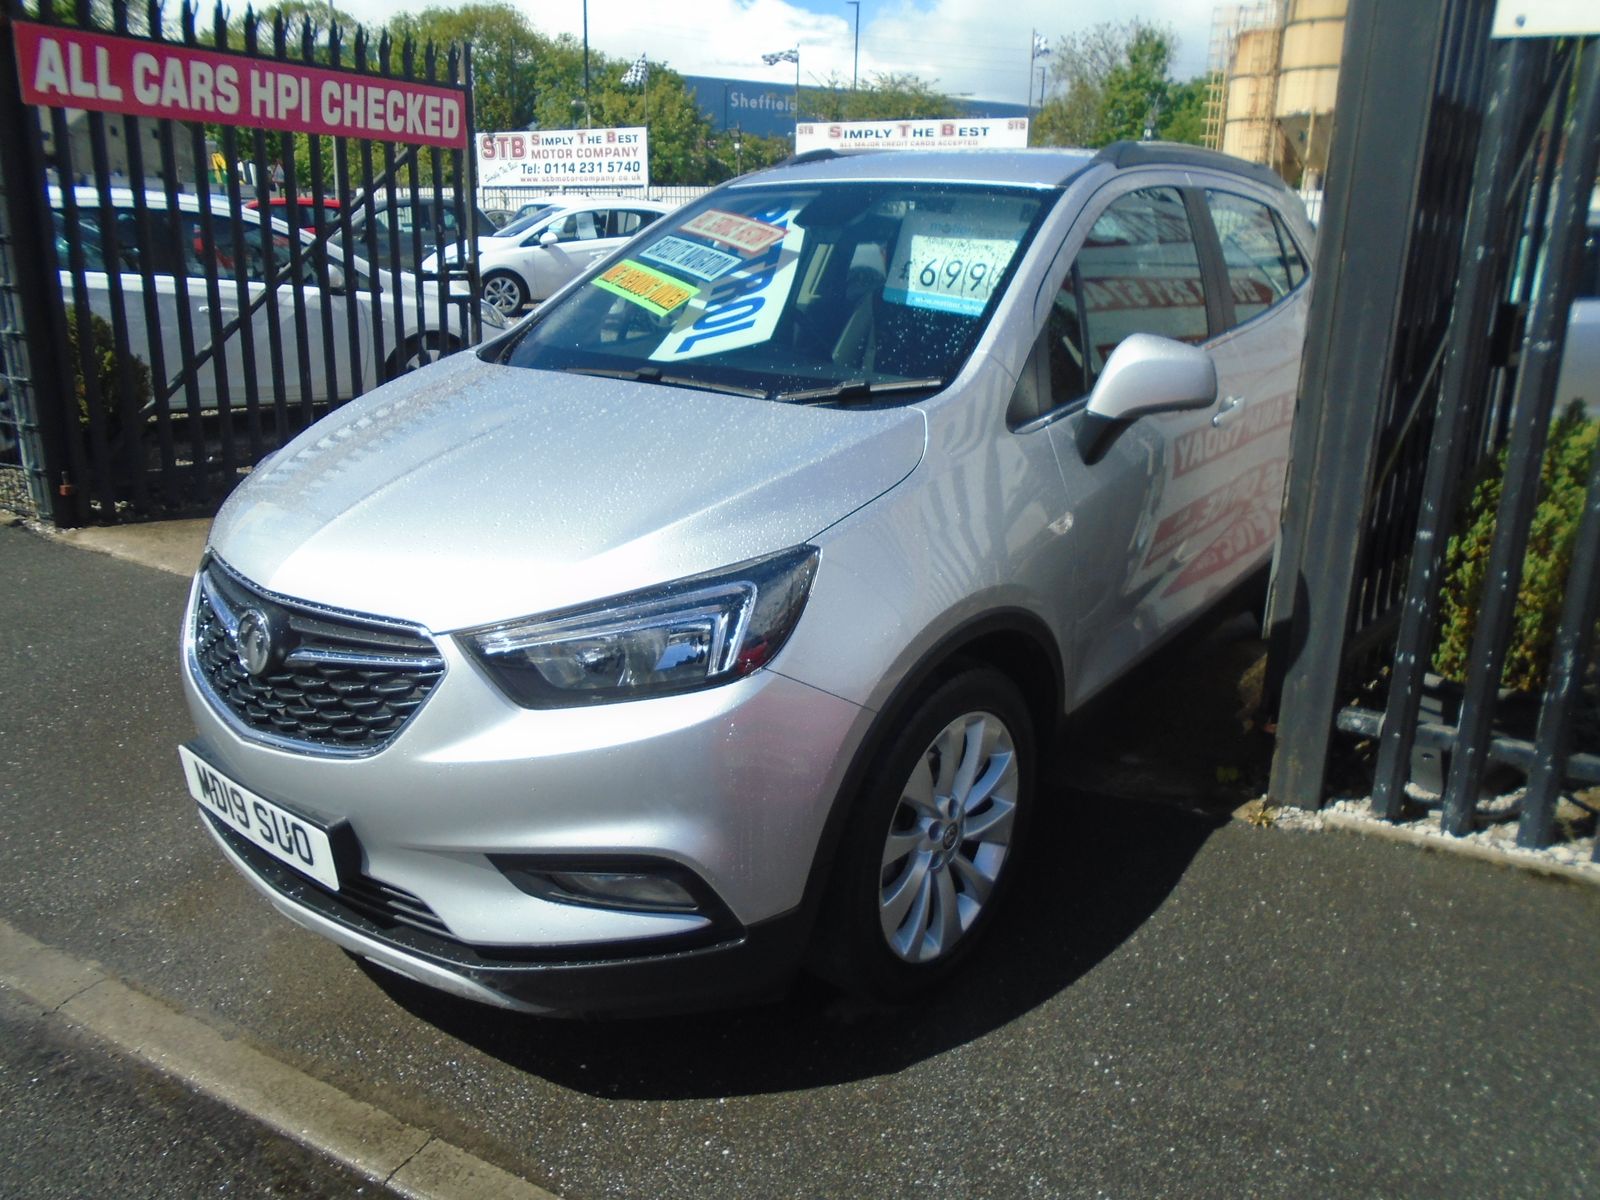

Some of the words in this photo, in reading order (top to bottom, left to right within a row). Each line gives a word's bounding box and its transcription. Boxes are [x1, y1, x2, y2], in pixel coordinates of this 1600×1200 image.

[34, 38, 123, 101] ALL
[133, 52, 240, 115] CARS
[251, 69, 311, 123] HPI
[321, 80, 460, 139] CHECKED
[941, 124, 990, 137] BEST
[481, 134, 527, 160] STB
[531, 149, 573, 160] MOTOR
[576, 147, 639, 159] COMPANY
[521, 163, 541, 175] Tel:
[544, 162, 576, 174] 0114
[579, 162, 602, 174] 231
[607, 161, 641, 173] 5740
[194, 760, 250, 829] MD19
[253, 801, 314, 867] SUO
